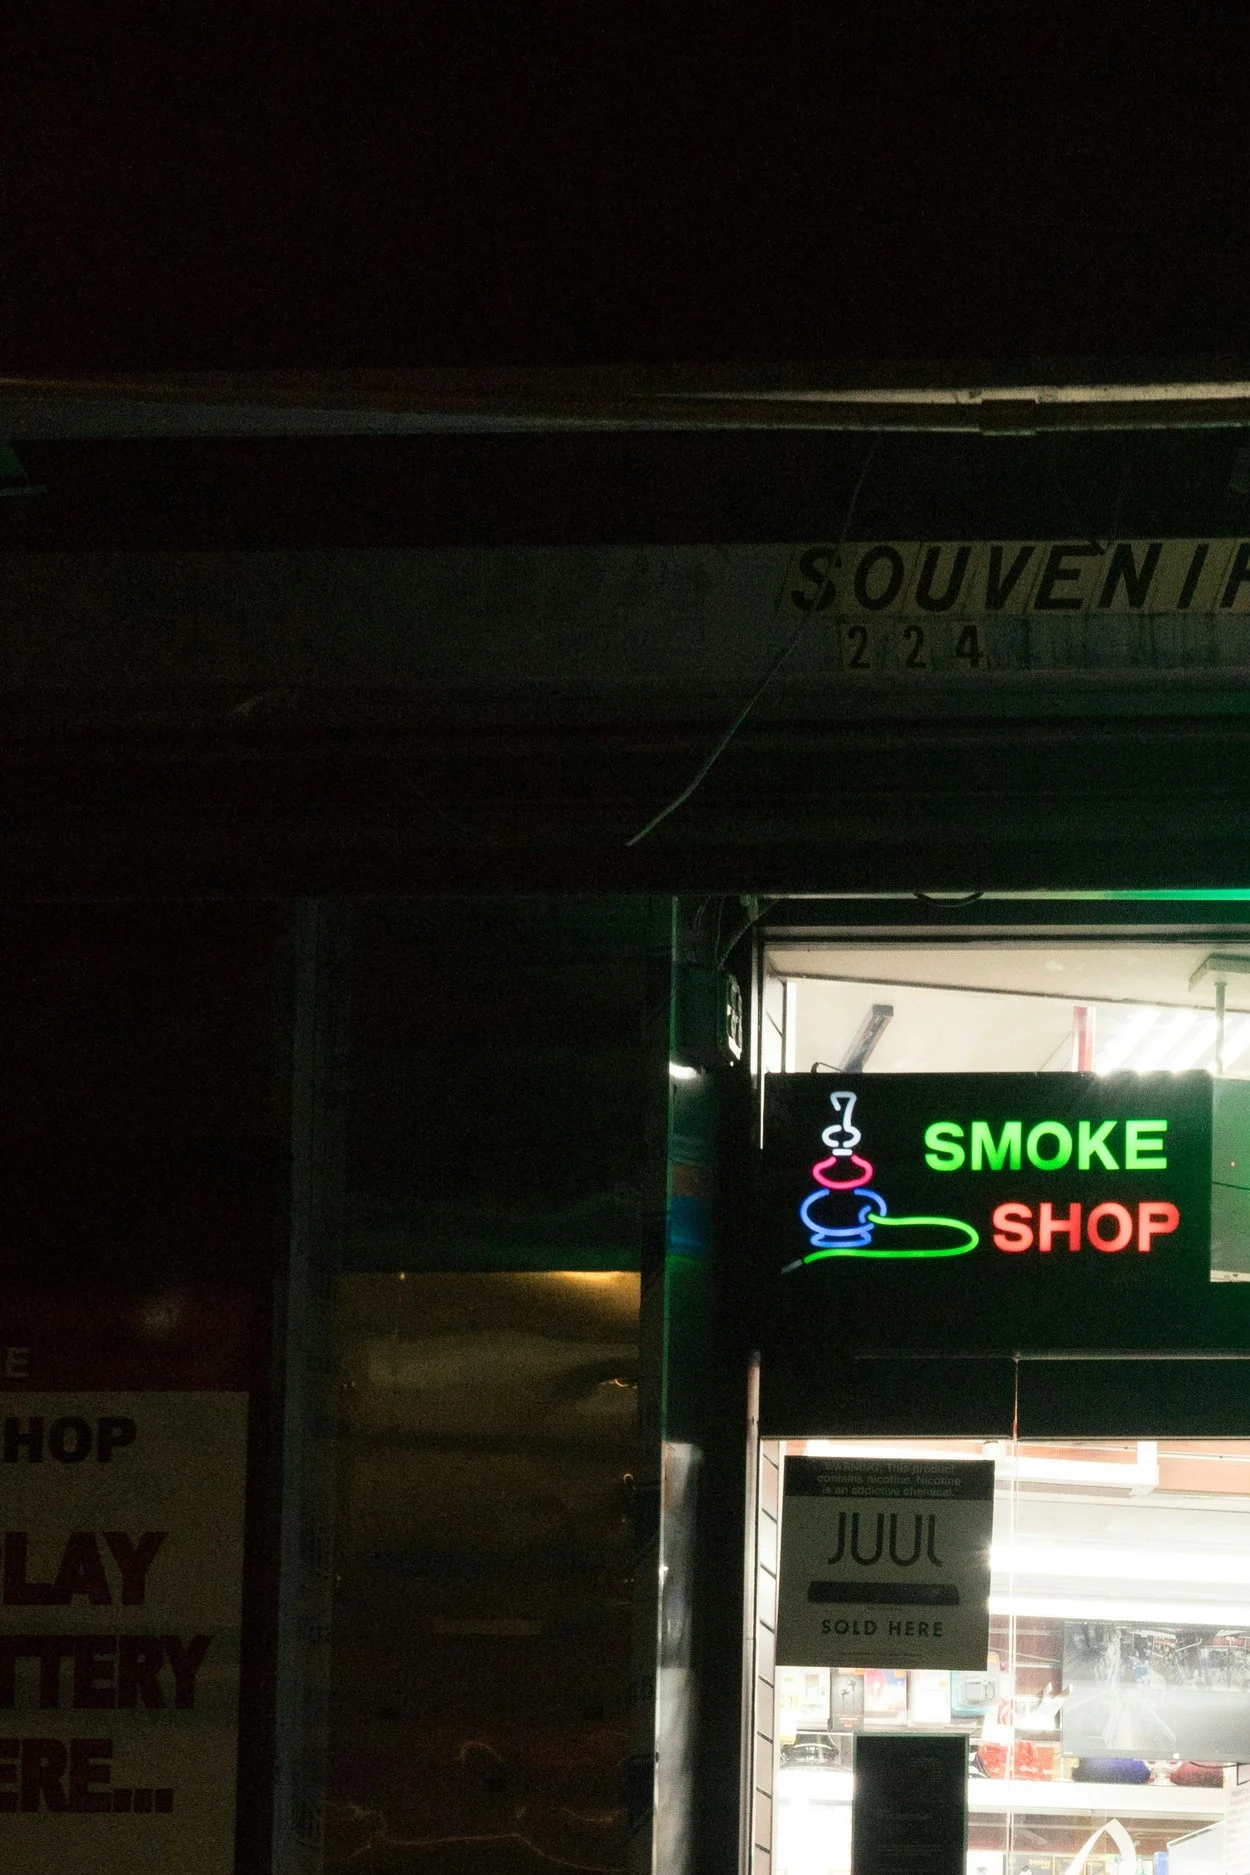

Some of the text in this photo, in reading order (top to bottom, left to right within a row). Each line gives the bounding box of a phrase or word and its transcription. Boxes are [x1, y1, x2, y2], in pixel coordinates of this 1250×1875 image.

[923, 1117, 1169, 1172] SMOKE
[991, 1202, 1181, 1253] SHOP
[827, 1512, 944, 1568] JUUL
[821, 1619, 944, 1638] SOLD HERE
